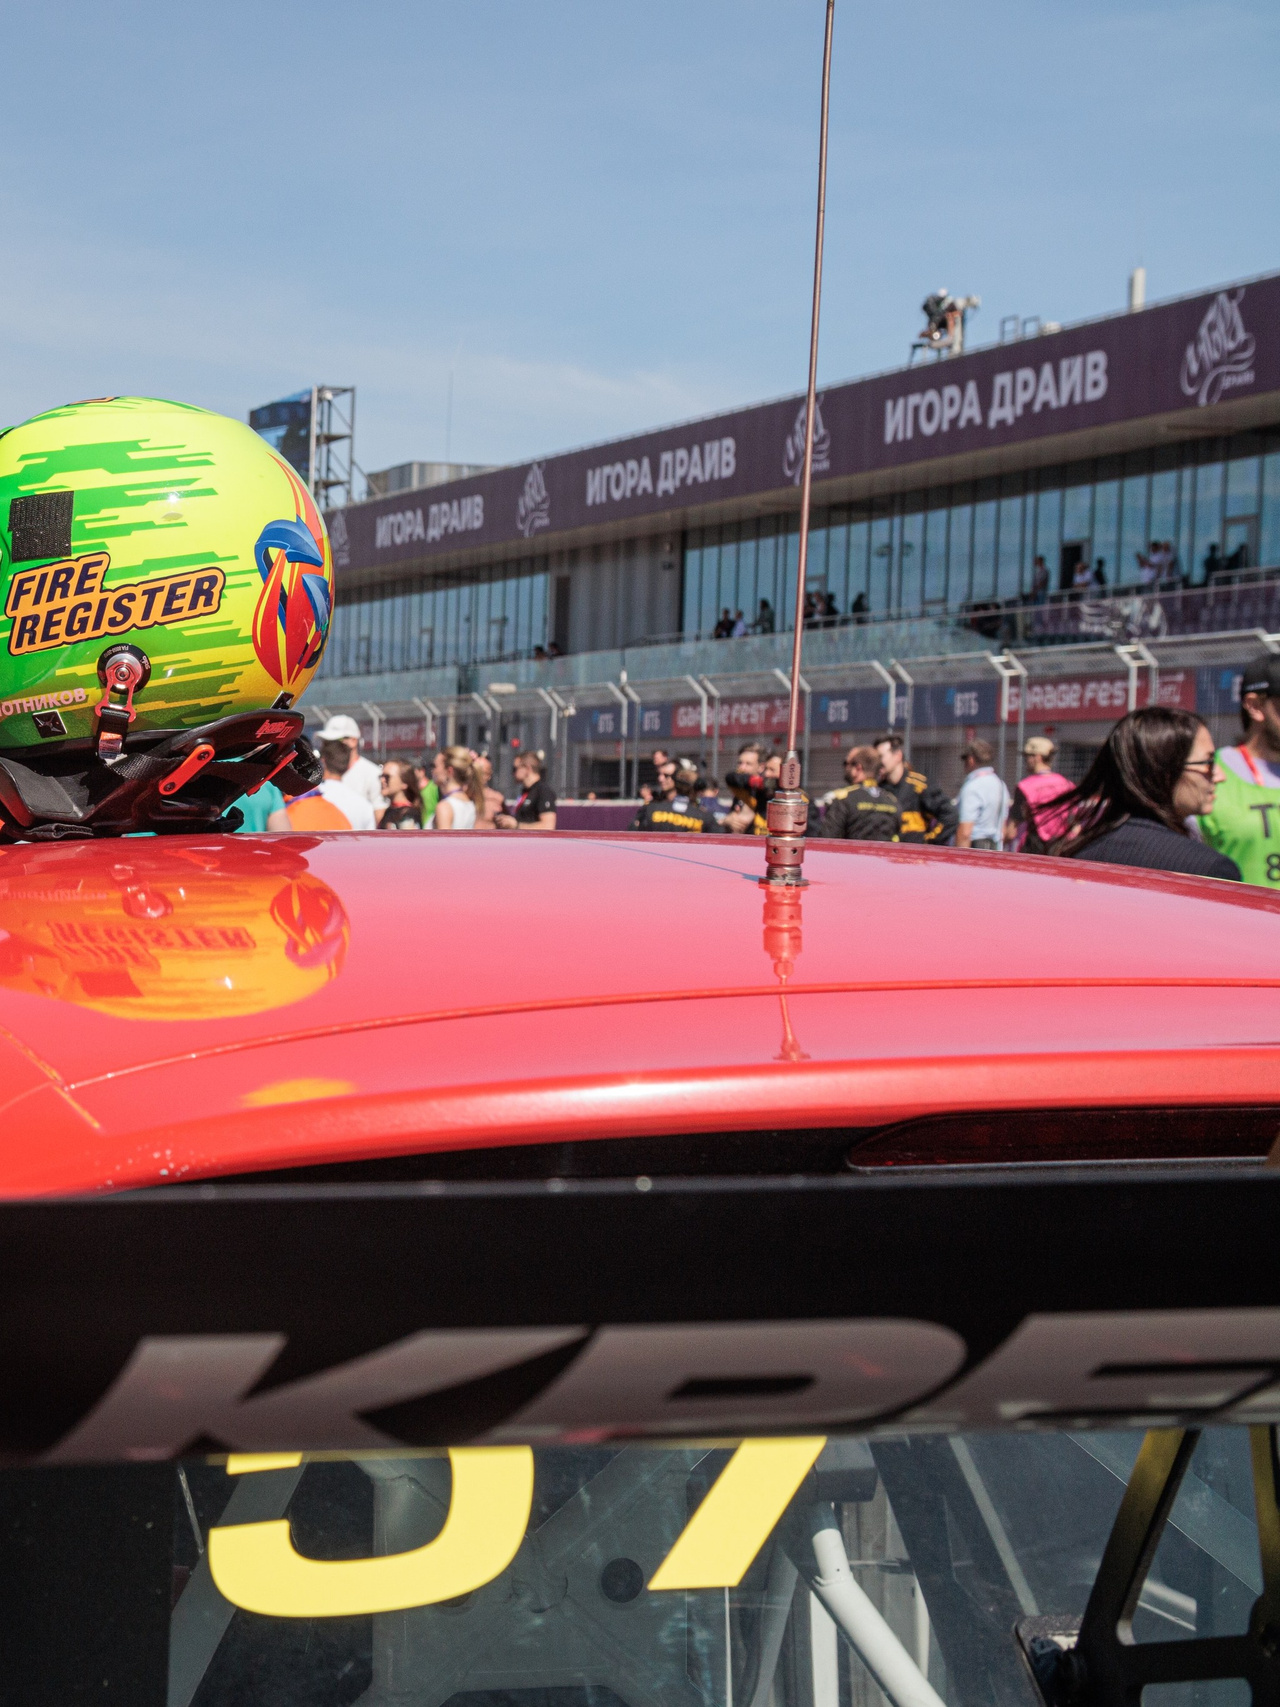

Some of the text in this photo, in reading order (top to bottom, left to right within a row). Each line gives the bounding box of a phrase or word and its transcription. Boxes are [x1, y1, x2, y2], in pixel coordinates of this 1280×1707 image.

[884, 379, 982, 445] ИГОРА
[988, 350, 1108, 430] ДРАЙВ
[586, 456, 653, 506] ИГОРА
[657, 436, 736, 498] ДРАЙВ
[375, 506, 424, 549] ИГОРА
[426, 495, 484, 543] ДРАЙВ
[16, 558, 105, 606] FIRE
[16, 575, 217, 647] REGISTER
[1250, 802, 1280, 838] T
